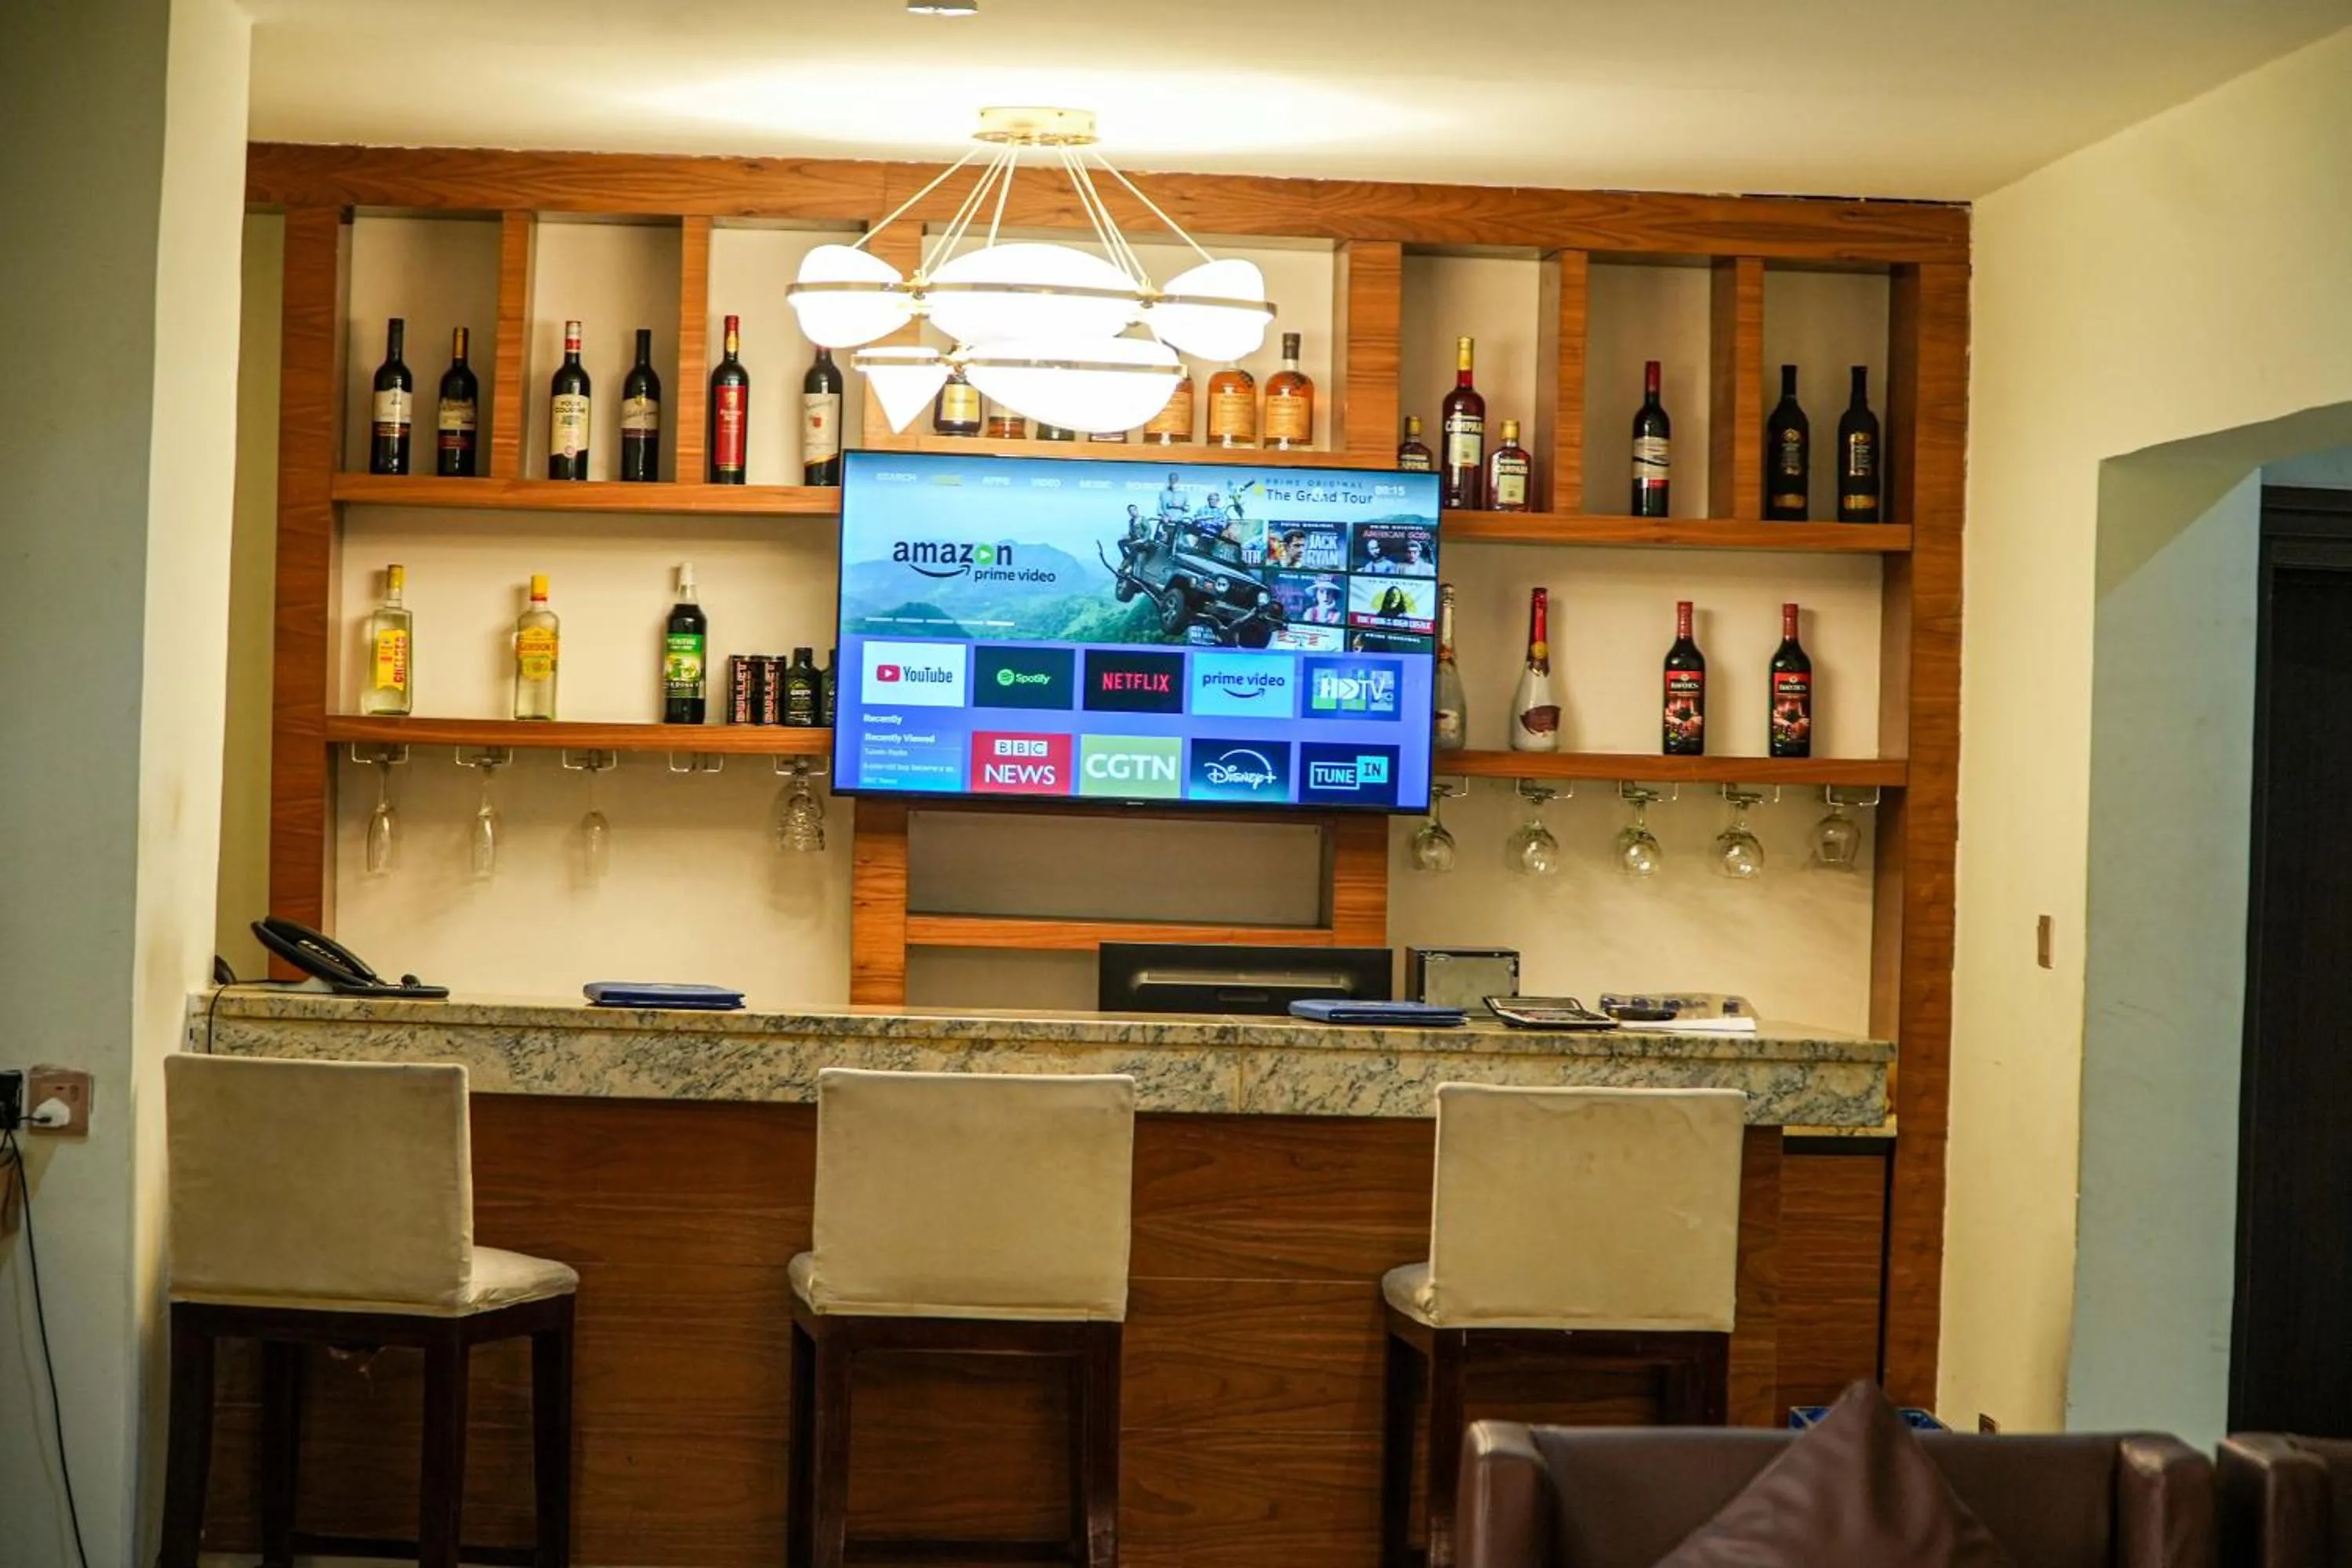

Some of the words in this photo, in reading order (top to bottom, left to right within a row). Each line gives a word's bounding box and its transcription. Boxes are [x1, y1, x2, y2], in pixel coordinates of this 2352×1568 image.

[1266, 488, 1290, 501] The
[1342, 491, 1374, 504] Tour
[1309, 534, 1338, 550] JACK
[975, 568, 1015, 582] prime
[1018, 569, 1056, 583] video
[903, 666, 953, 684] YouTube
[1015, 673, 1051, 685] Spotify
[1102, 672, 1170, 693] NETFLIX
[1203, 673, 1244, 687] prime
[1247, 672, 1286, 687] video
[863, 714, 902, 725] Recently
[865, 733, 901, 744] Recently
[902, 733, 935, 743] Viewed
[994, 739, 1048, 757] BBC
[984, 764, 1056, 785] NEWS
[1085, 753, 1177, 781] CGTN
[1315, 767, 1355, 784] TUNE
[1363, 761, 1381, 776] IN
